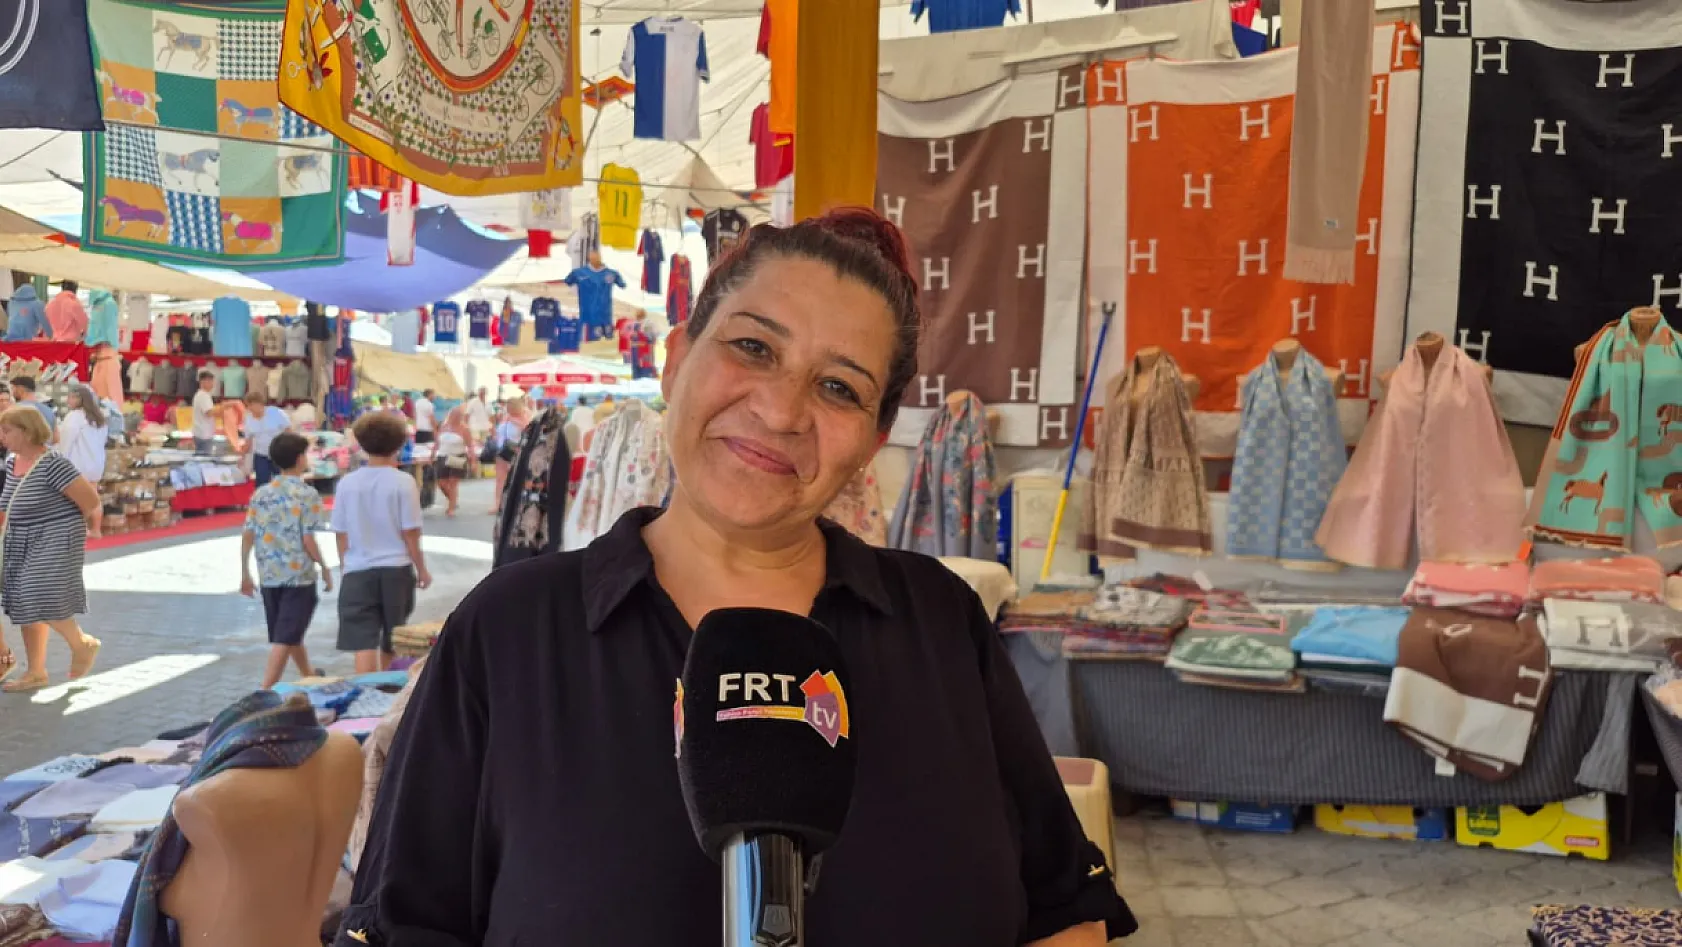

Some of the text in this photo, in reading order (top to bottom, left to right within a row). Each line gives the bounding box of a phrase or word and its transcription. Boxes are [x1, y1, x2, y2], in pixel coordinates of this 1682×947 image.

[1435, 1, 1468, 33] H
[1475, 40, 1509, 74] H
[1596, 53, 1635, 87] H
[1059, 71, 1086, 108] H
[1095, 67, 1126, 102] H
[1022, 119, 1051, 153] H
[1130, 105, 1160, 142] H
[1239, 103, 1271, 141] H
[1531, 119, 1566, 155] H
[928, 139, 955, 173] H
[614, 189, 628, 217] 11
[972, 185, 998, 223] H
[1183, 173, 1212, 209] H
[1467, 184, 1501, 219] H
[883, 193, 906, 228] H
[1589, 198, 1627, 234] H
[1016, 244, 1045, 278] H
[1129, 239, 1157, 273] H
[1237, 239, 1268, 276] H
[923, 257, 950, 290] H
[1523, 261, 1558, 300] H
[1653, 274, 1682, 308] H
[438, 315, 455, 332] 10
[967, 310, 995, 344] H
[1181, 308, 1211, 343] H
[1291, 295, 1316, 335] H
[1459, 328, 1491, 364] H
[919, 375, 946, 406] H
[1009, 368, 1037, 400] H
[1339, 359, 1368, 394] H
[1040, 408, 1068, 439] H
[719, 672, 796, 701] FRT
[812, 701, 837, 729] tv
